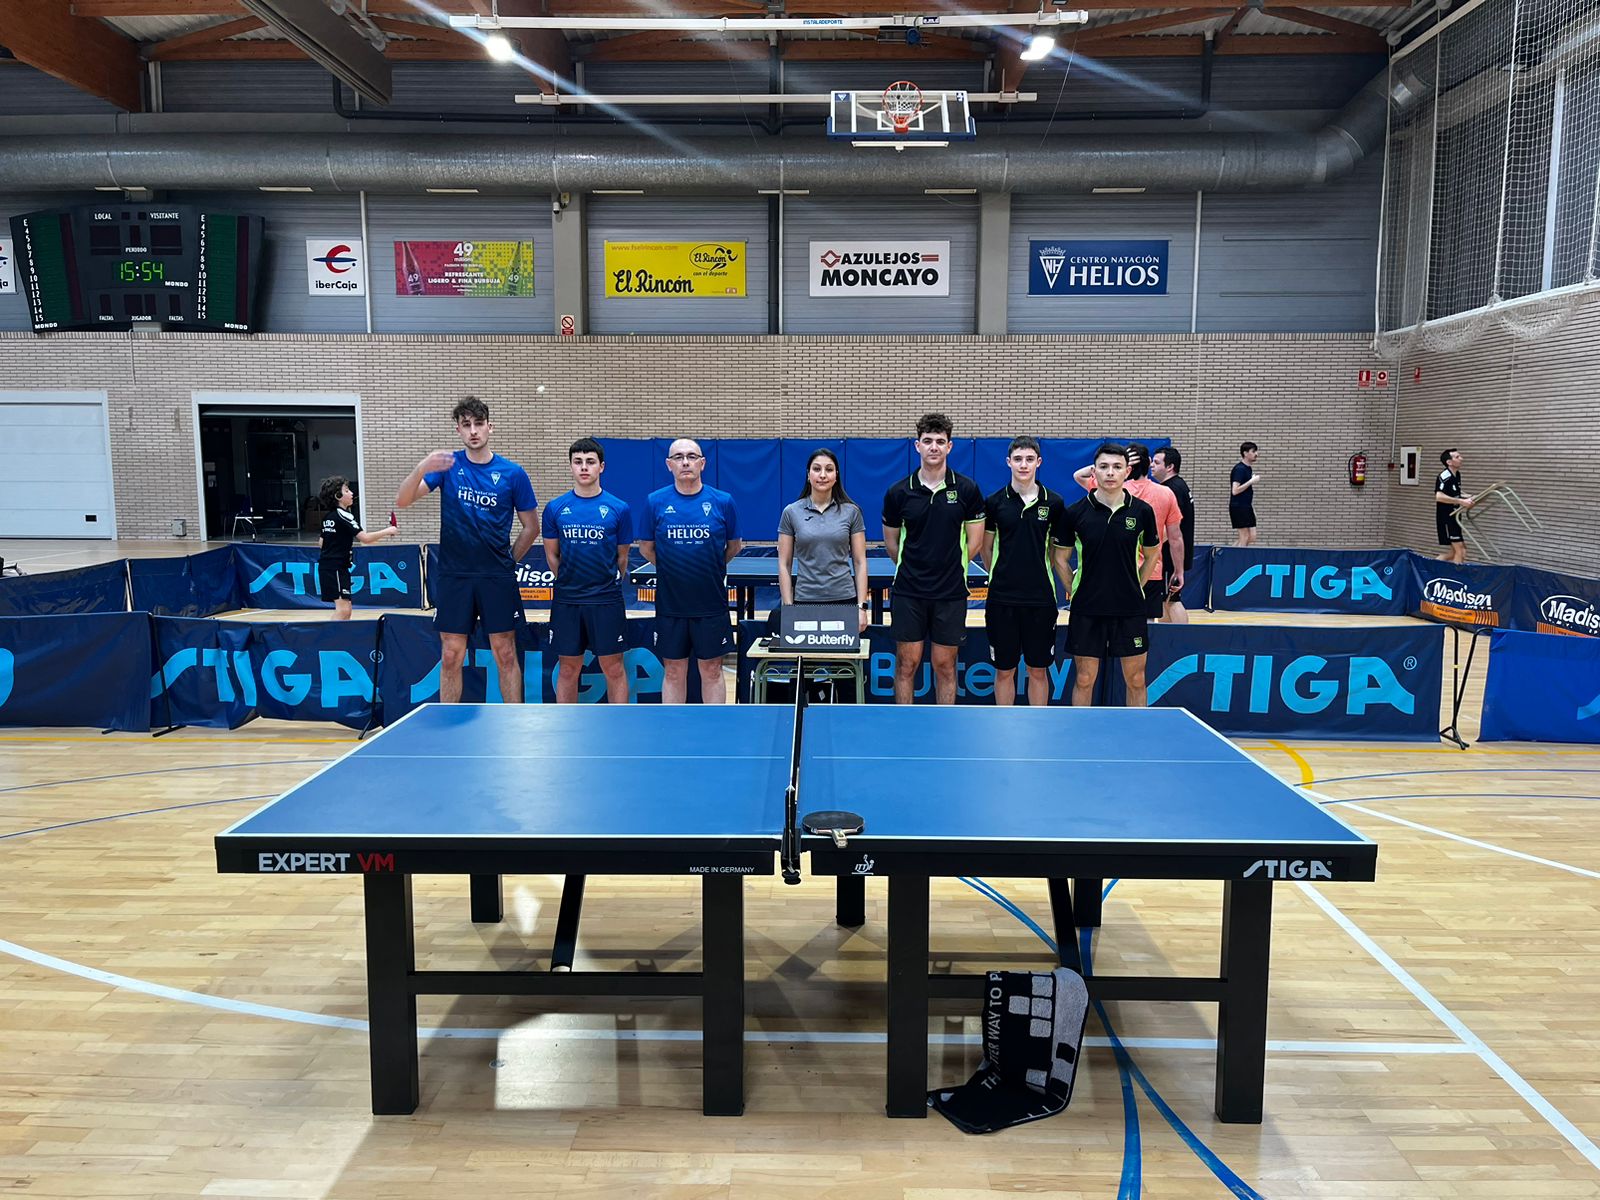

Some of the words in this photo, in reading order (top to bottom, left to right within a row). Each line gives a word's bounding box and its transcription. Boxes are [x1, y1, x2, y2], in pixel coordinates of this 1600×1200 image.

[23, 219, 29, 227] E
[201, 214, 206, 222] E
[200, 247, 205, 255] 7
[453, 242, 474, 257] 49
[200, 255, 205, 263] 8
[841, 252, 920, 265] AZULEJOS
[1111, 254, 1160, 263] NATACIÓN
[120, 261, 163, 281] 15:54
[200, 263, 205, 271] 9
[198, 271, 207, 279] 10
[408, 273, 419, 283] 49
[508, 274, 519, 283] 49
[613, 269, 633, 293] El
[634, 269, 694, 293] Rincón
[820, 268, 939, 287] MONCAYO
[1069, 265, 1160, 286] HELIOS
[315, 280, 358, 291] iberCaja
[224, 322, 248, 330] MONDO
[563, 528, 604, 540] HELIOS
[667, 528, 710, 539] HELIOS
[1225, 564, 1392, 600] STIGA
[1433, 582, 1492, 606] Madison
[1548, 600, 1600, 629] Madis
[807, 634, 855, 646] Butterfly
[150, 647, 382, 709] STIGA
[1147, 653, 1415, 715] STIGA
[258, 853, 350, 872] EXPERT
[357, 853, 394, 872] VM
[1243, 860, 1332, 879] STIGA
[989, 971, 1003, 981] P
[989, 987, 1002, 1007] TO
[987, 1010, 1001, 1040] WAY
